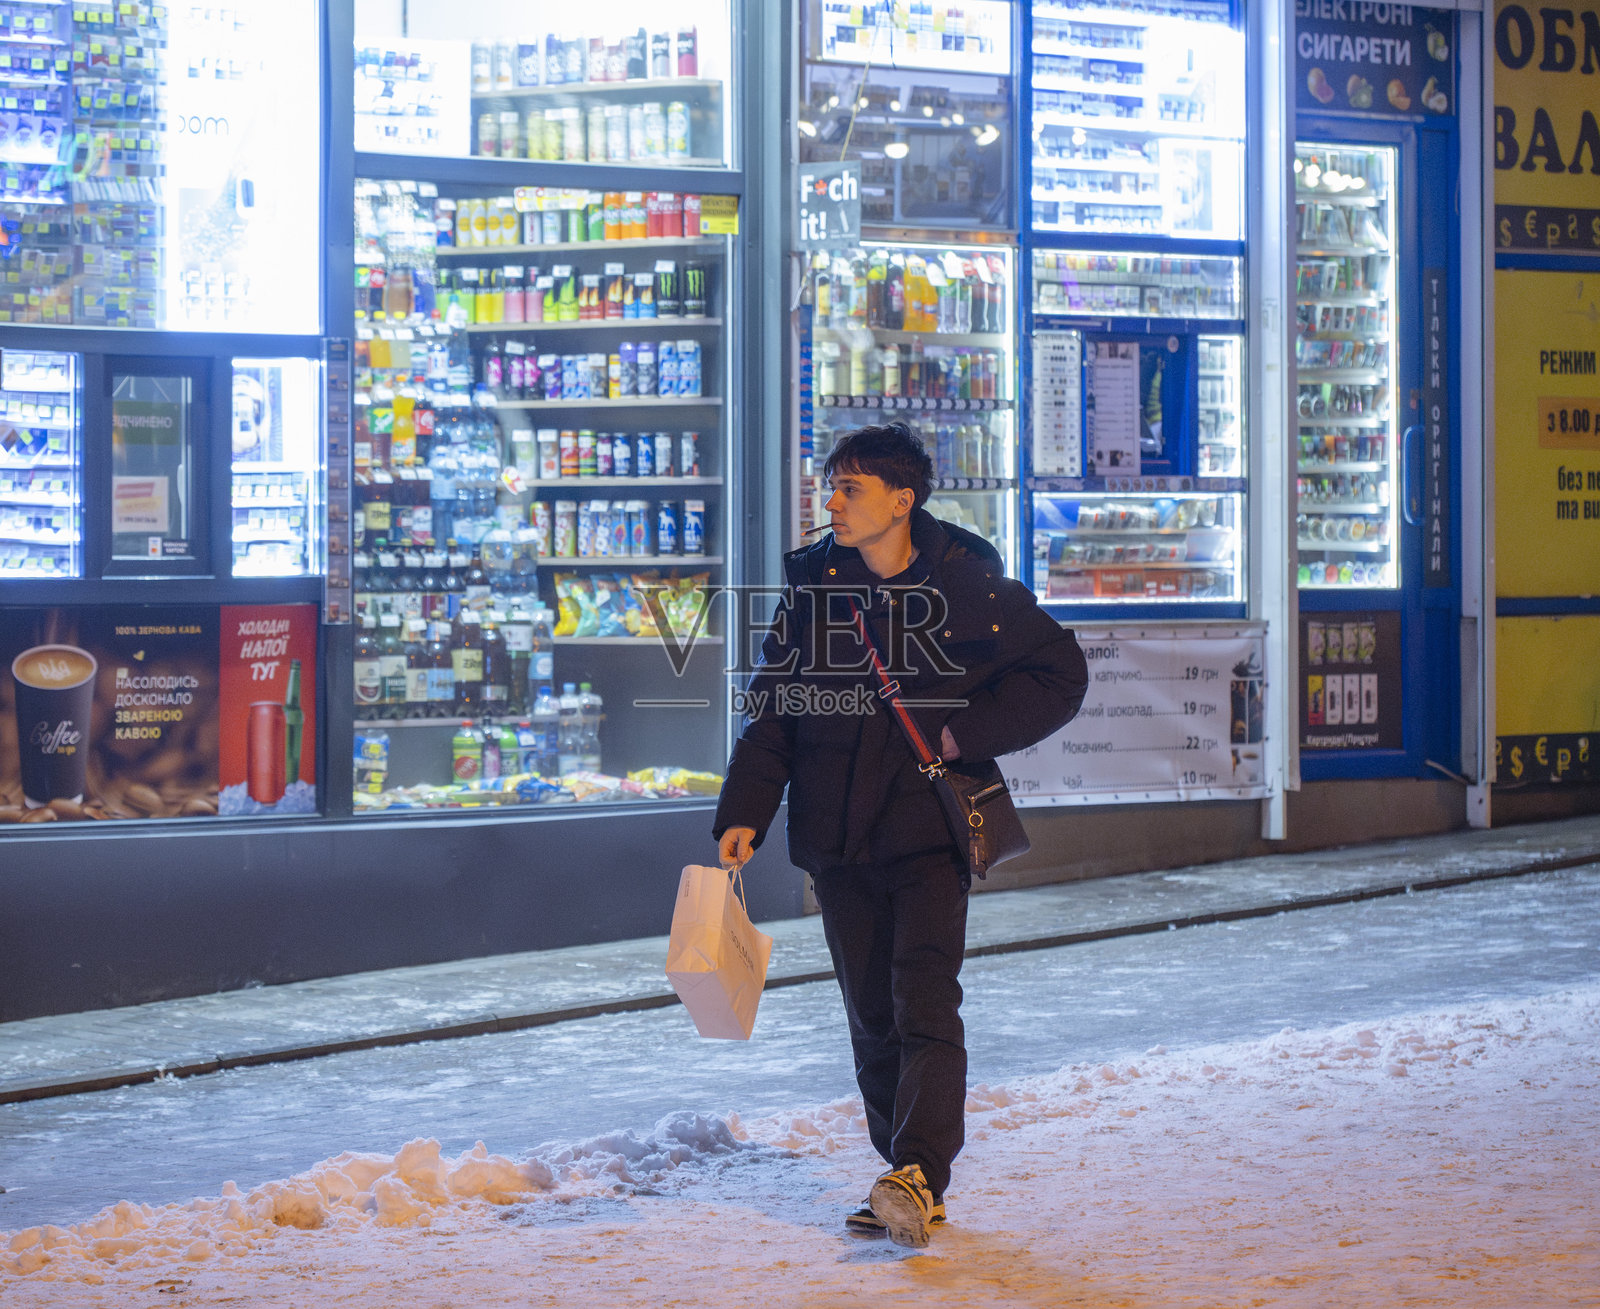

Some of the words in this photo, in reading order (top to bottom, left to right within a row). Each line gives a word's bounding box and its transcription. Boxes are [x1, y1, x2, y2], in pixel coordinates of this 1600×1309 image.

[1299, 33, 1411, 66] СИГАРЕТИ
[1495, 106, 1600, 175] ВАЛ
[801, 209, 827, 240] it!
[1431, 279, 1440, 388] ТІЛЬКИ
[1541, 351, 1596, 374] РЕЖИМ
[1560, 409, 1590, 433] 8.00
[1558, 465, 1583, 491] без
[1431, 405, 1441, 571] ОРИГІНАЛИ
[179, 625, 201, 635] КАВА
[237, 620, 290, 636] ХОЛОДНІ
[241, 635, 290, 659] НАПОЇ
[251, 661, 280, 681] ТУТ
[1095, 670, 1142, 685] капучино
[1184, 667, 1198, 680] 19
[1202, 669, 1218, 683] грн
[115, 675, 199, 690] НАСОЛОДИСЬ
[115, 692, 193, 707] ДОСКОНАЛО
[115, 709, 183, 723] ЗВАРЕНОЮ
[1107, 705, 1153, 718] шоколад
[1183, 702, 1196, 715] 19
[1200, 704, 1216, 718] грн
[30, 720, 82, 754] Coffee
[115, 726, 161, 740] КАВОЮ
[1062, 740, 1113, 755] Мокачино
[1186, 737, 1199, 750] 22
[1202, 738, 1218, 752] грн
[1023, 779, 1040, 793] грн
[1063, 774, 1082, 789] Чай
[1183, 771, 1196, 784] 10
[1199, 772, 1216, 786] грн
